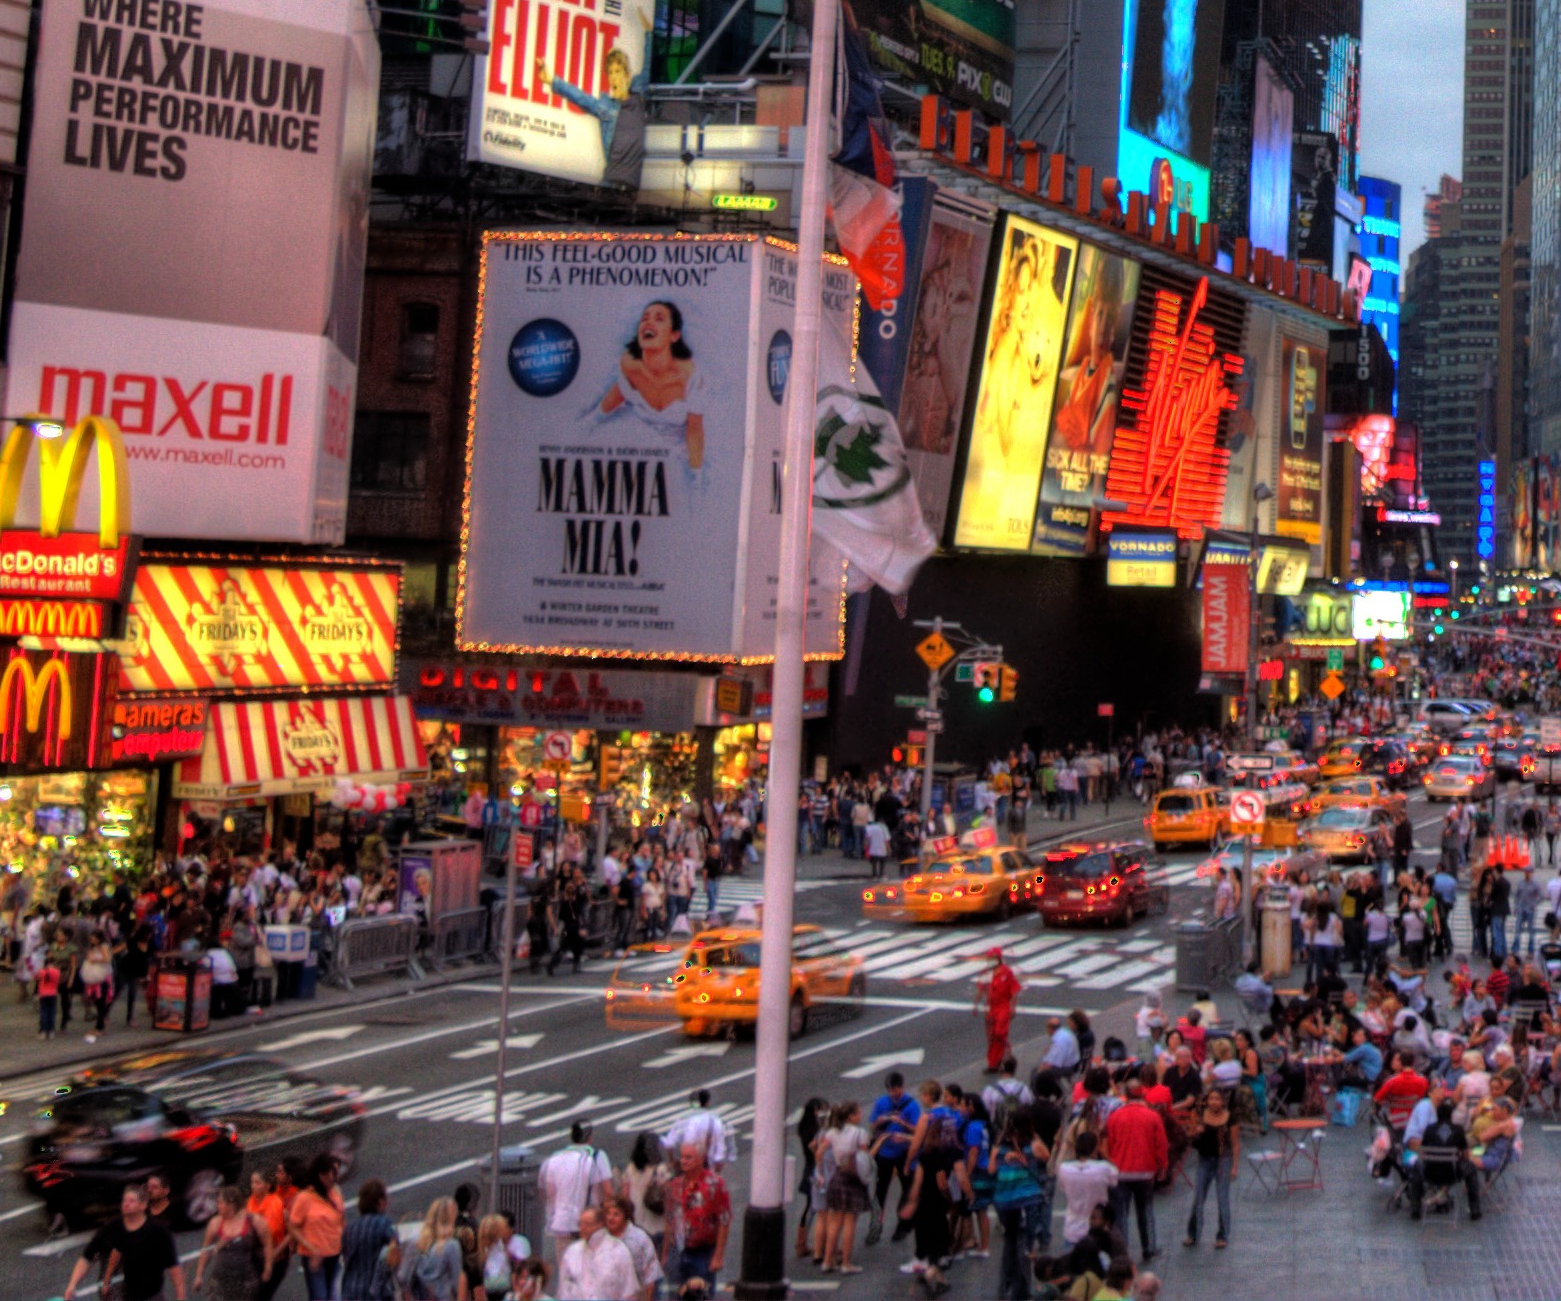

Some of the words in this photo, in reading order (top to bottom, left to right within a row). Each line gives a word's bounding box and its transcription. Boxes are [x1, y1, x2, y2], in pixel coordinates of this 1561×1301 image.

[73, 20, 325, 117] MAXIMUM
[69, 77, 320, 155] PERFORMANCE
[64, 117, 188, 182] LIVES
[495, 243, 545, 263] "THIS
[550, 244, 657, 265] FEEL-GOOD
[662, 243, 749, 265] MUSICAL
[525, 266, 541, 284] IS
[548, 267, 562, 285] A
[567, 265, 717, 288] PHENOMENON!"
[39, 364, 294, 447] maxell
[536, 457, 670, 517] MAMMA
[561, 519, 641, 576] MIA!
[1109, 540, 1176, 553] VORNADO
[1126, 565, 1158, 577] Retail
[1207, 575, 1228, 668] JAMJAM
[420, 666, 610, 700] DIGITAL
